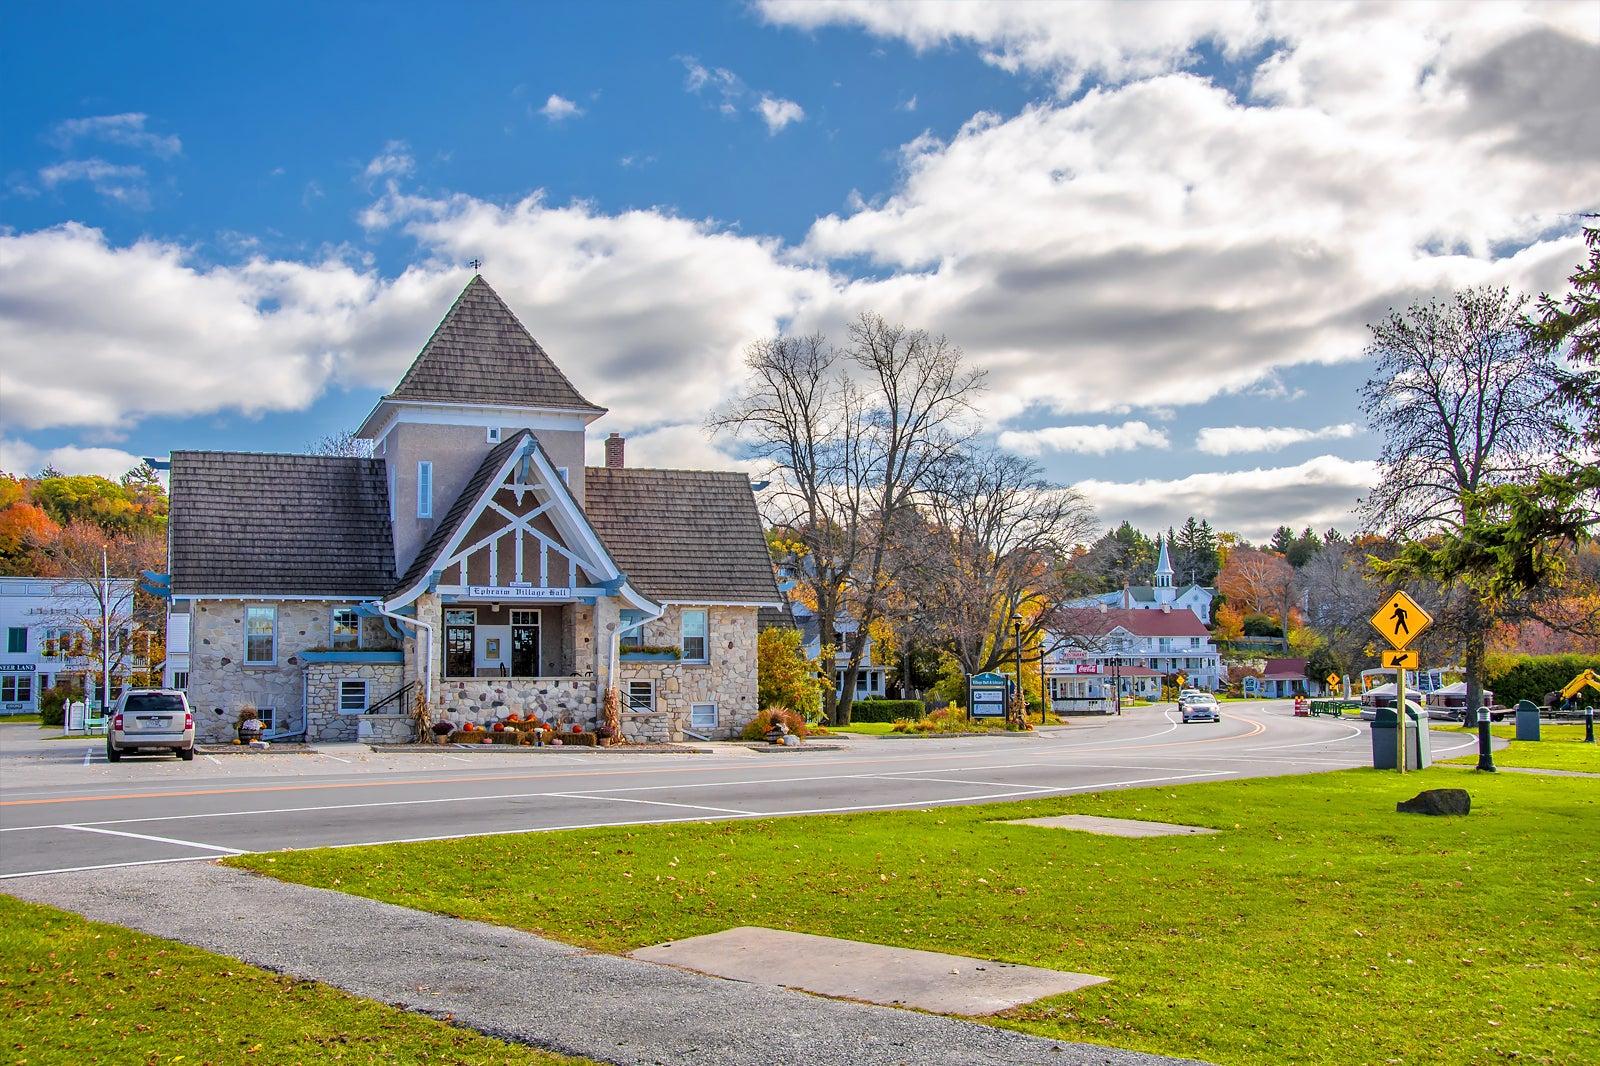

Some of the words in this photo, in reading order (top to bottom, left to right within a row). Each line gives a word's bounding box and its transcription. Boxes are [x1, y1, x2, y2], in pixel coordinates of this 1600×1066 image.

[474, 587, 510, 595] Ephraim
[515, 588, 545, 597] Village
[549, 588, 566, 596] Hall
